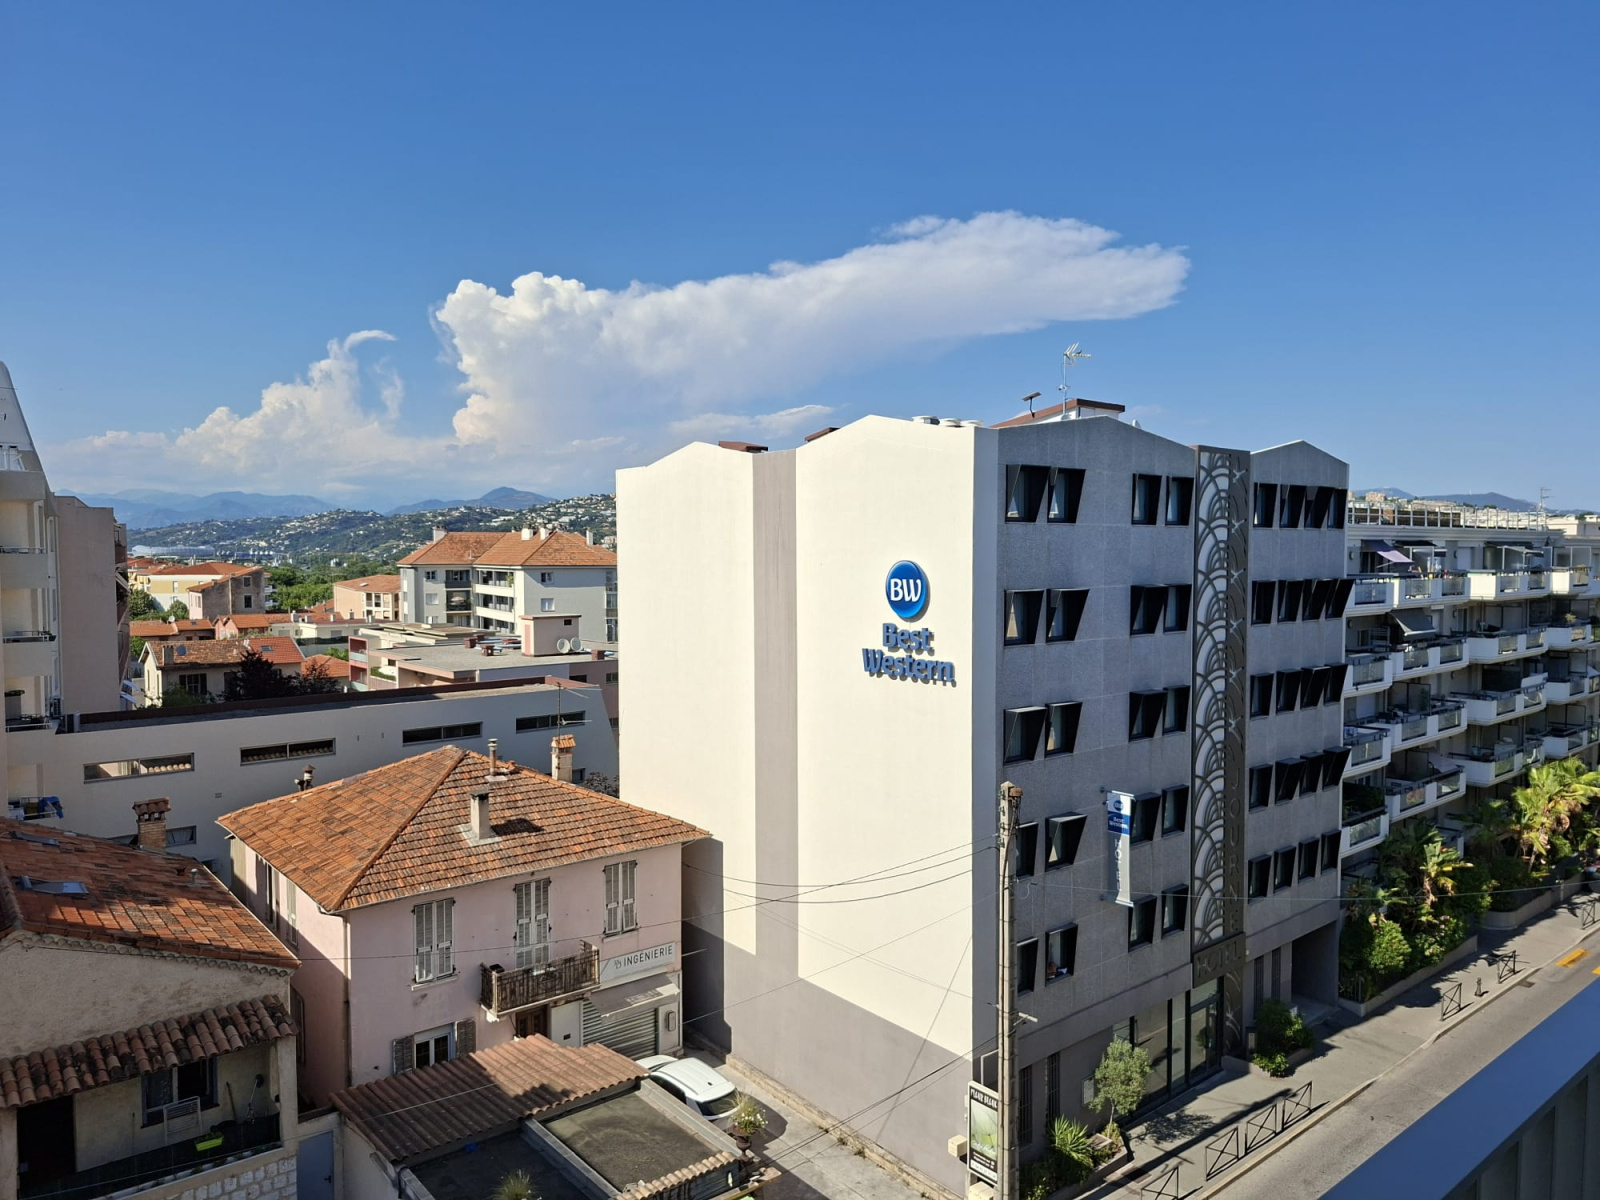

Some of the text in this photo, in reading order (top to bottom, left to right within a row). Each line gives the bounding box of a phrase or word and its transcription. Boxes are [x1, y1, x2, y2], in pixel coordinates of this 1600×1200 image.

[890, 578, 922, 602] BW
[882, 623, 931, 651] Best
[862, 648, 954, 682] Western
[1197, 940, 1242, 978] HOTEL
